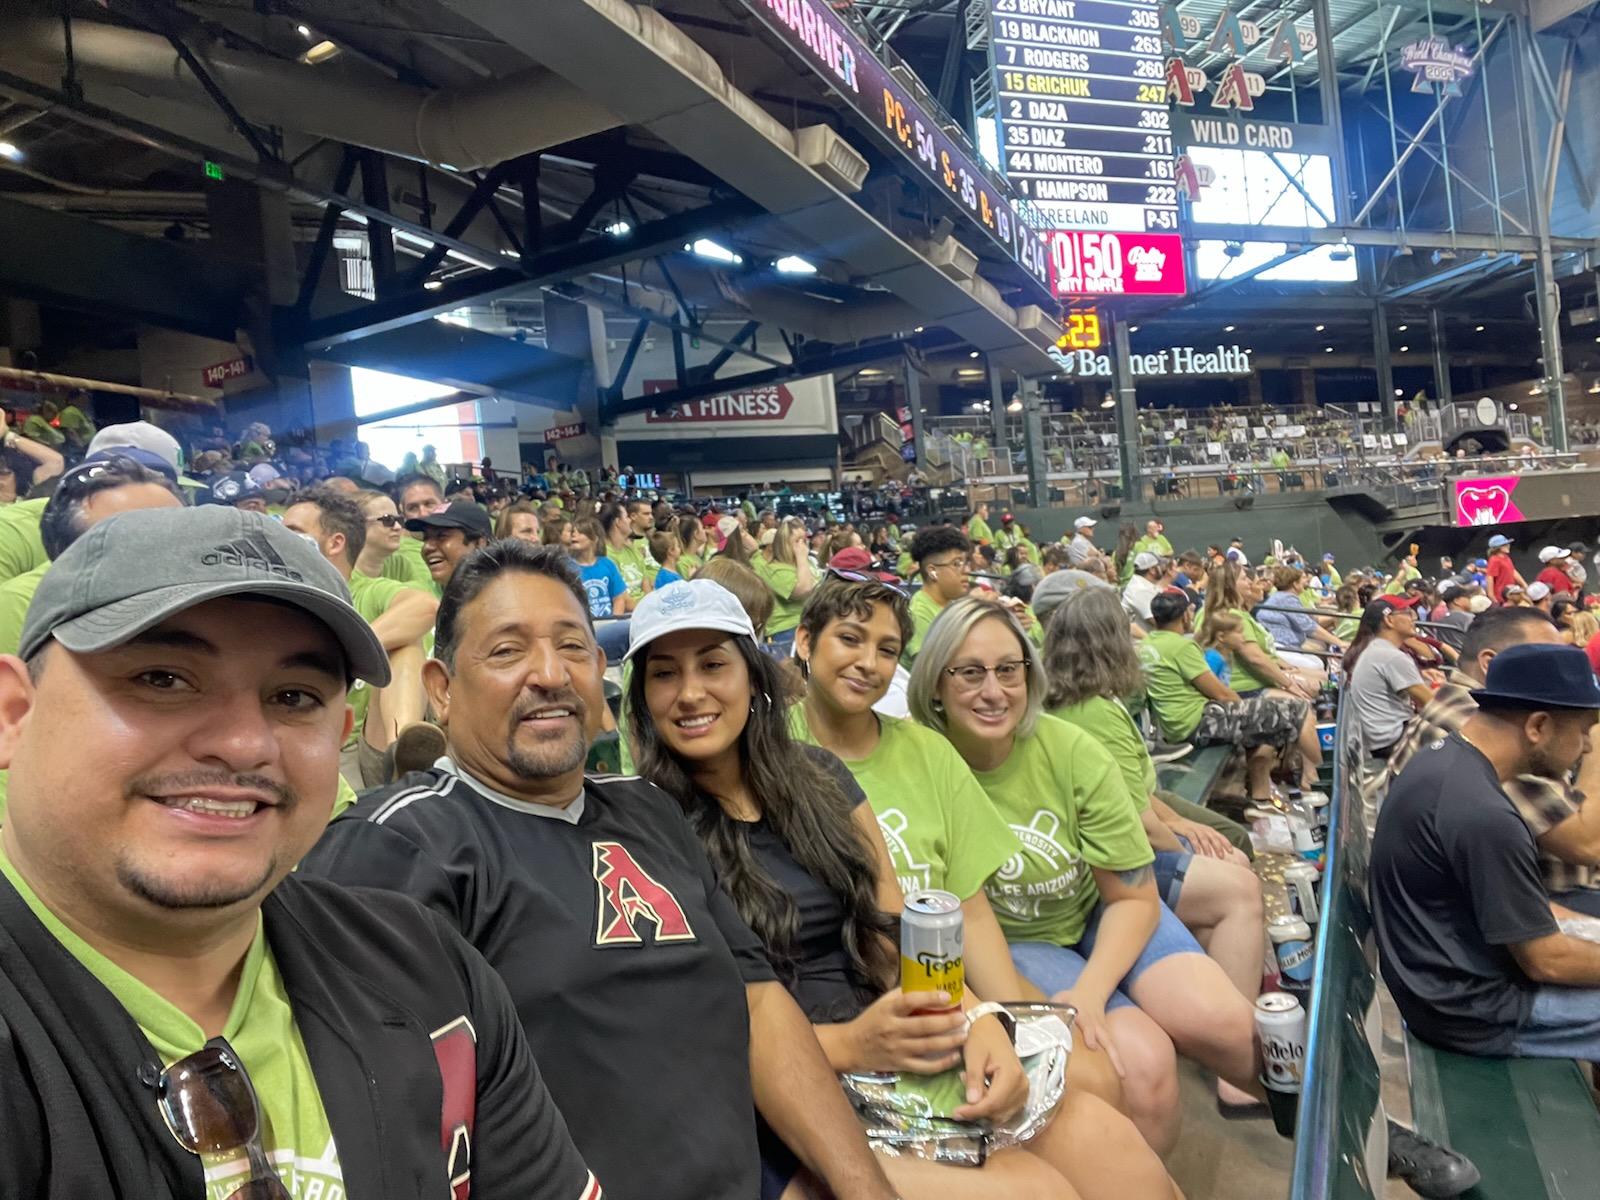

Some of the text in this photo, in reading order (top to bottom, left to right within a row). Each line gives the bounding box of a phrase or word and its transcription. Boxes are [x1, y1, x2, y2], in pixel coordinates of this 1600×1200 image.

[1020, 0, 1075, 19] BRYANT
[1128, 9, 1160, 29] .305
[1181, 18, 1197, 33] 99
[1000, 20, 1162, 54] 19 BLACKMON .263
[1241, 24, 1255, 40] 01
[1299, 32, 1314, 47] 02
[1005, 47, 1164, 79] 7 RODGERS .260
[1004, 72, 1167, 104] 15 GRICHUK .247
[1187, 71, 1202, 86] 07
[1010, 100, 1169, 130] 2 DAZA .302
[1008, 126, 1172, 154] 35 DIAZ .211
[1191, 119, 1293, 149] WILD CARD
[883, 88, 912, 149] PC:
[915, 120, 936, 171] 54
[941, 150, 957, 192] S:
[959, 168, 977, 210] 35
[995, 206, 1010, 243] 19
[1009, 152, 1175, 178] 44 MONTERO .161
[1020, 180, 1176, 204] 1 HAMPSON .222
[1147, 210, 1178, 229] P-51
[1077, 345, 1251, 376] Baner Health
[700, 394, 780, 417] FITNESS
[201, 552, 304, 583] adidas
[1014, 830, 1061, 859] EROSITY
[1026, 865, 1080, 897] ARIZONA
[918, 951, 961, 977] Topo
[1264, 1041, 1304, 1061] odelo
